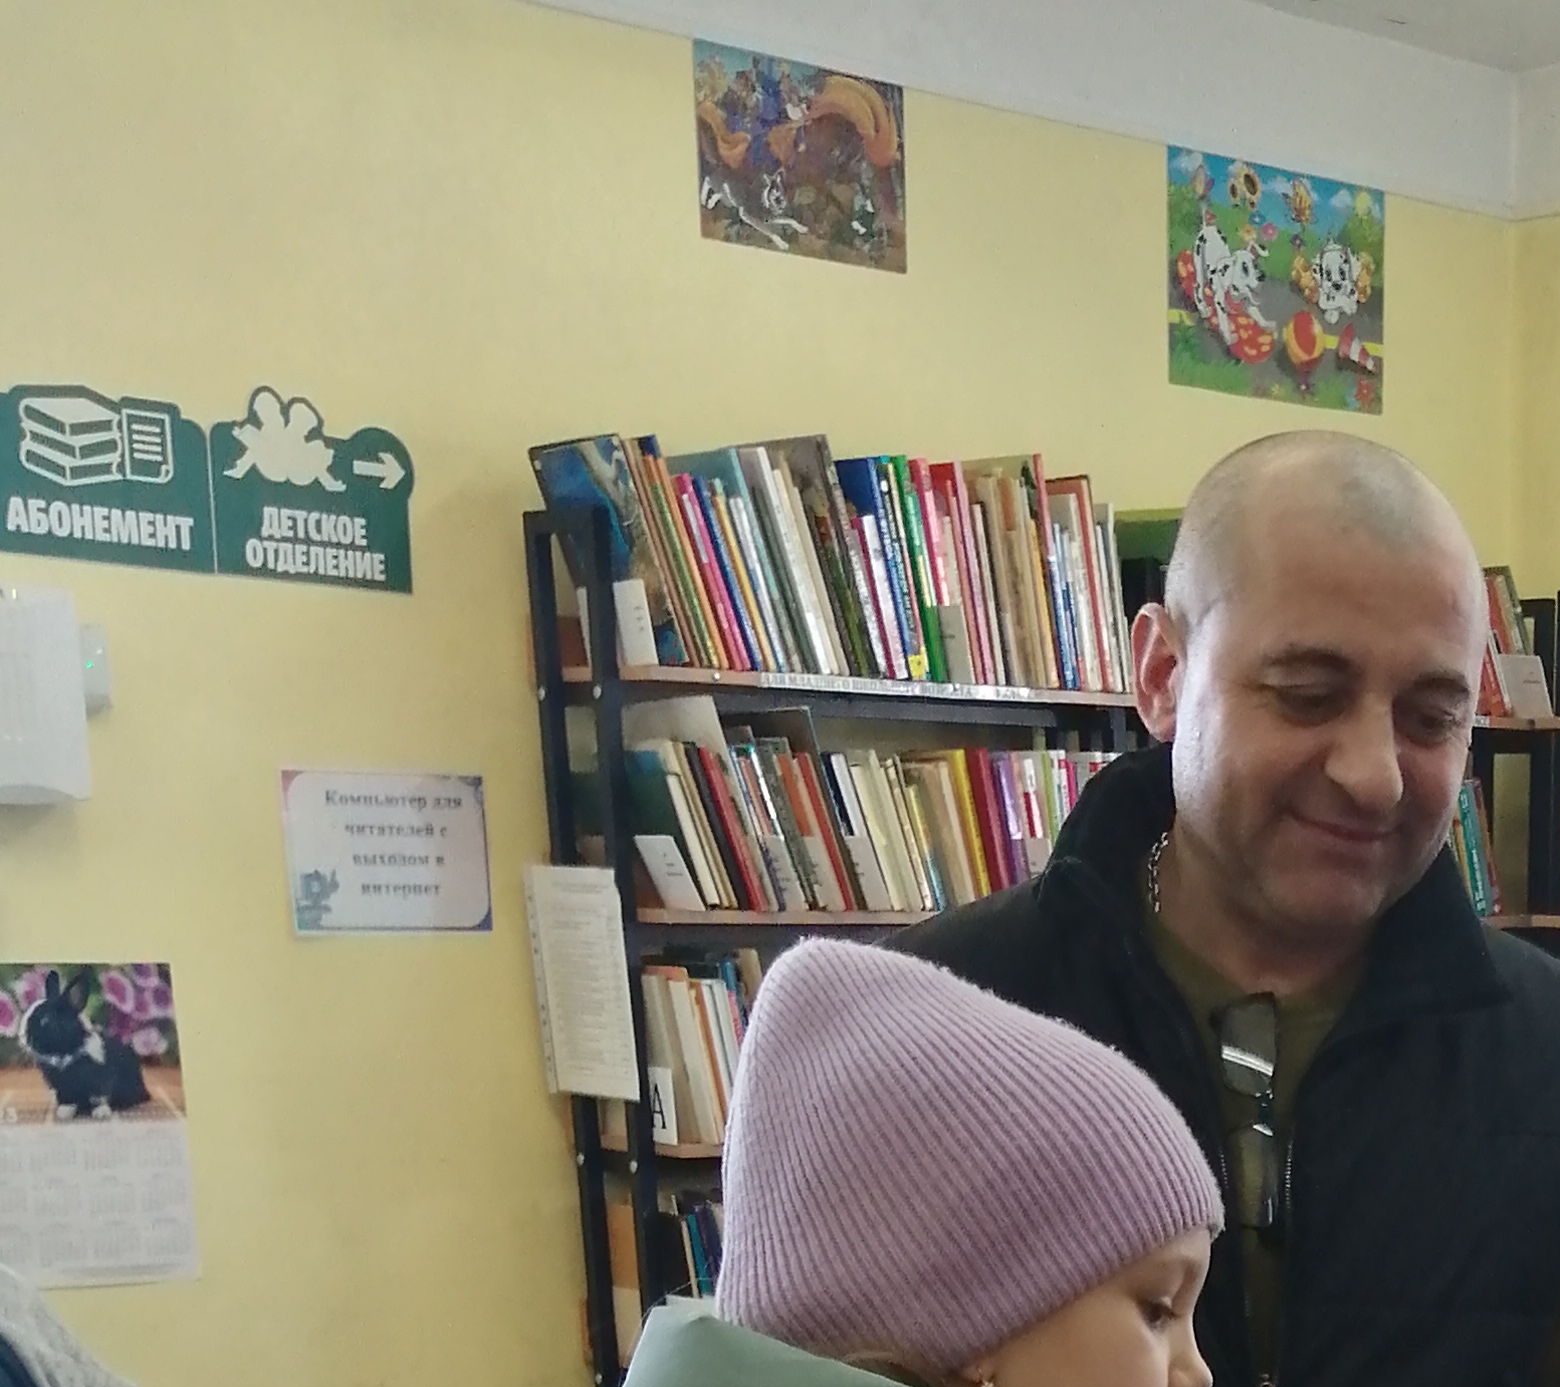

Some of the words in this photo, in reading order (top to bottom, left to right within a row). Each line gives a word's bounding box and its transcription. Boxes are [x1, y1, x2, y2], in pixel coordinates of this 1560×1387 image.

[7, 496, 195, 551] АБОНЕМЕНТ
[261, 506, 367, 547] ДЕТСКОЕ
[245, 538, 386, 582] ОТДЕЛЕНИЕ
[325, 789, 428, 812] Компьютер
[344, 822, 435, 838] читателей
[352, 854, 430, 867] выходом
[360, 883, 440, 899] интернет
[651, 1083, 667, 1130] А
